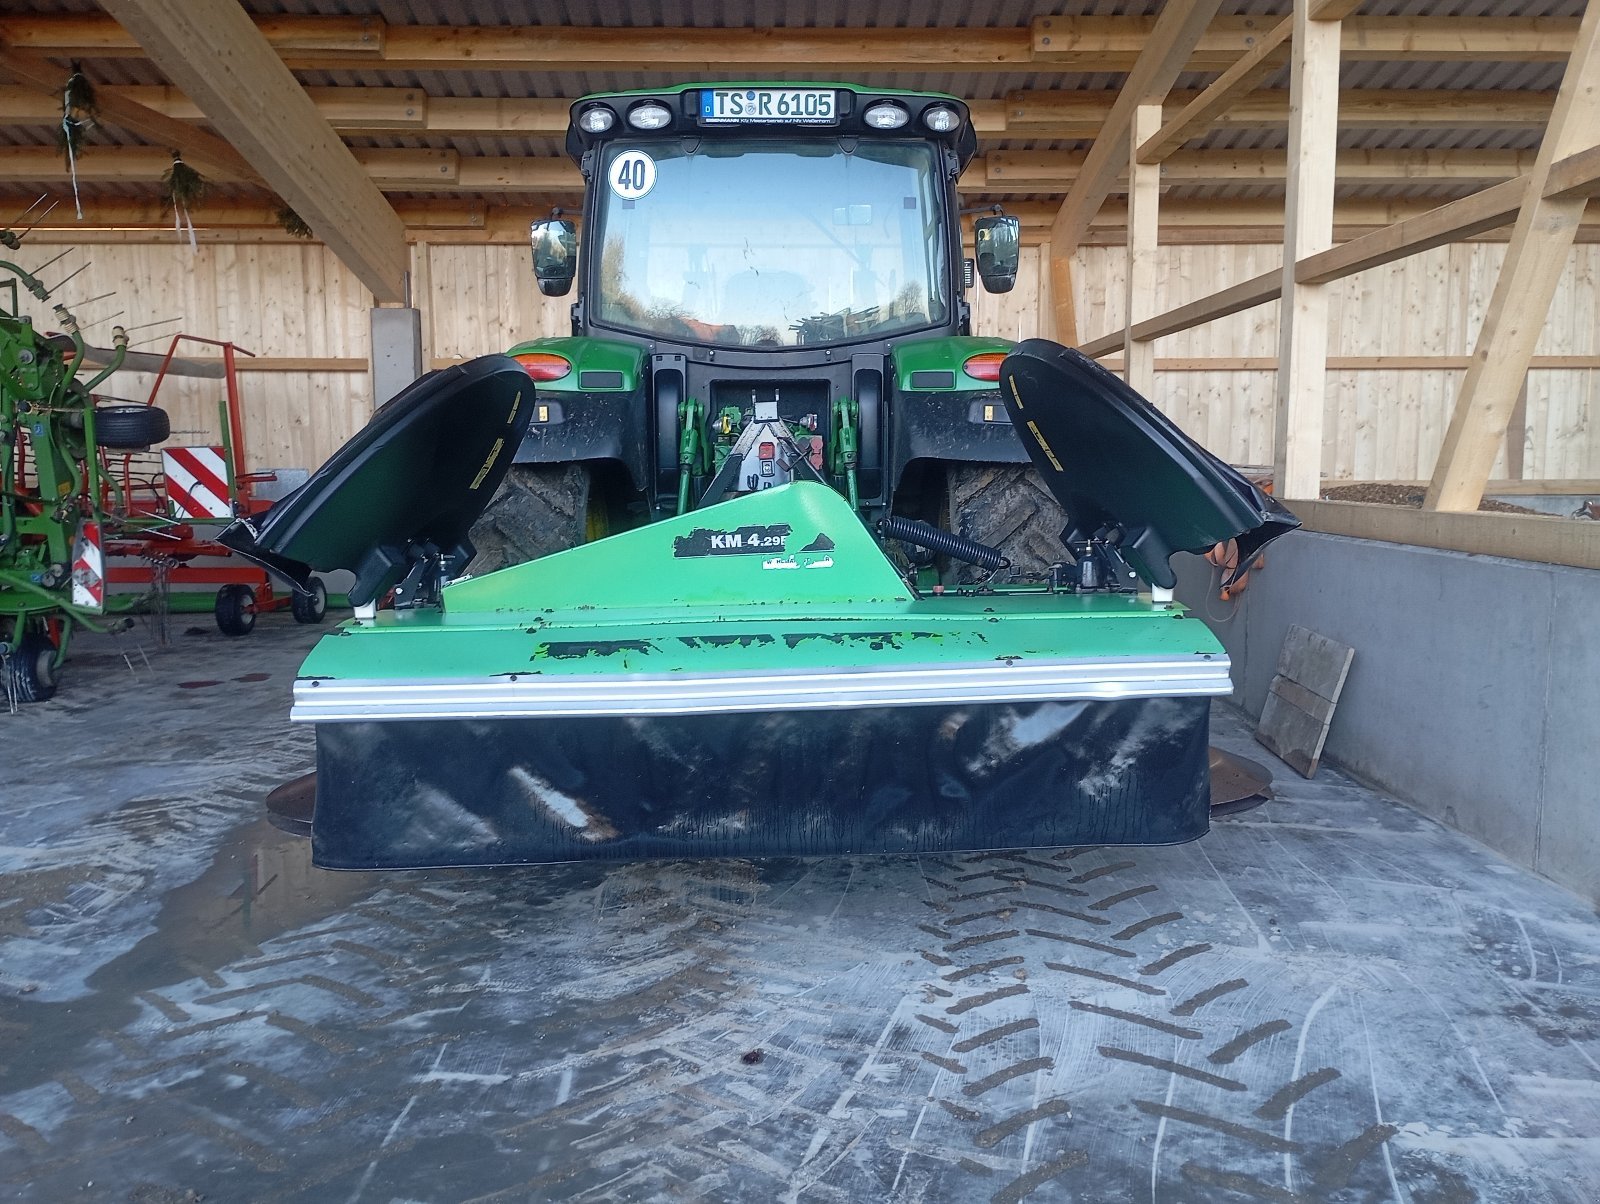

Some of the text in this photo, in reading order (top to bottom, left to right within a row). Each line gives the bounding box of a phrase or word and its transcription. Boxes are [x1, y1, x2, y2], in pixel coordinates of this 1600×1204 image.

[715, 92, 832, 116] TS R 6105
[618, 159, 646, 191] 40
[711, 534, 742, 549] KM
